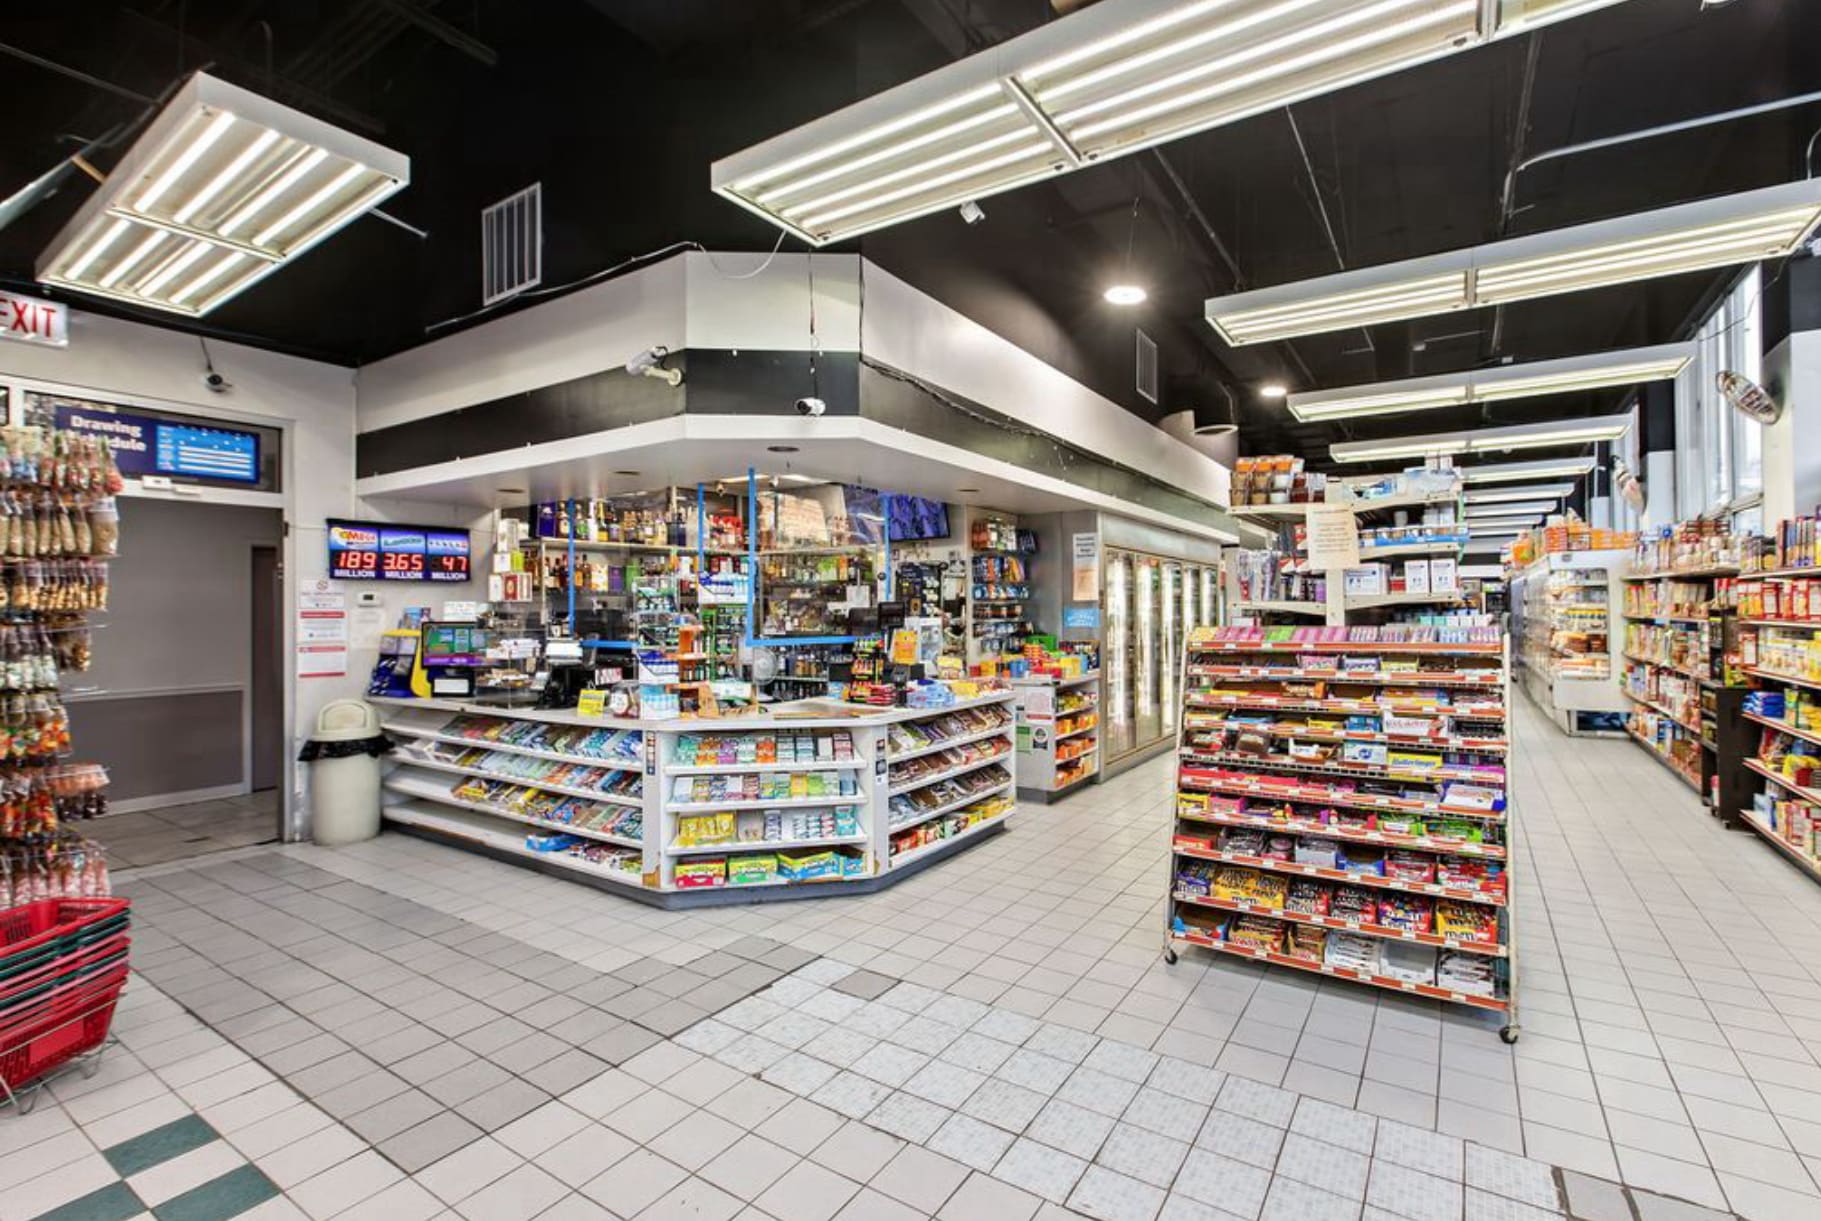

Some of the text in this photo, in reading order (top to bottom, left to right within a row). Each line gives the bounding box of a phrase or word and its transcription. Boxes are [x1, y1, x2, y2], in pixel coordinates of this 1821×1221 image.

[71, 415, 142, 438] Drawing
[339, 551, 377, 569] 189
[442, 556, 467, 571] 47
[334, 569, 376, 578] MILLION
[385, 571, 423, 579] MILLION
[432, 572, 467, 580] MILLION
